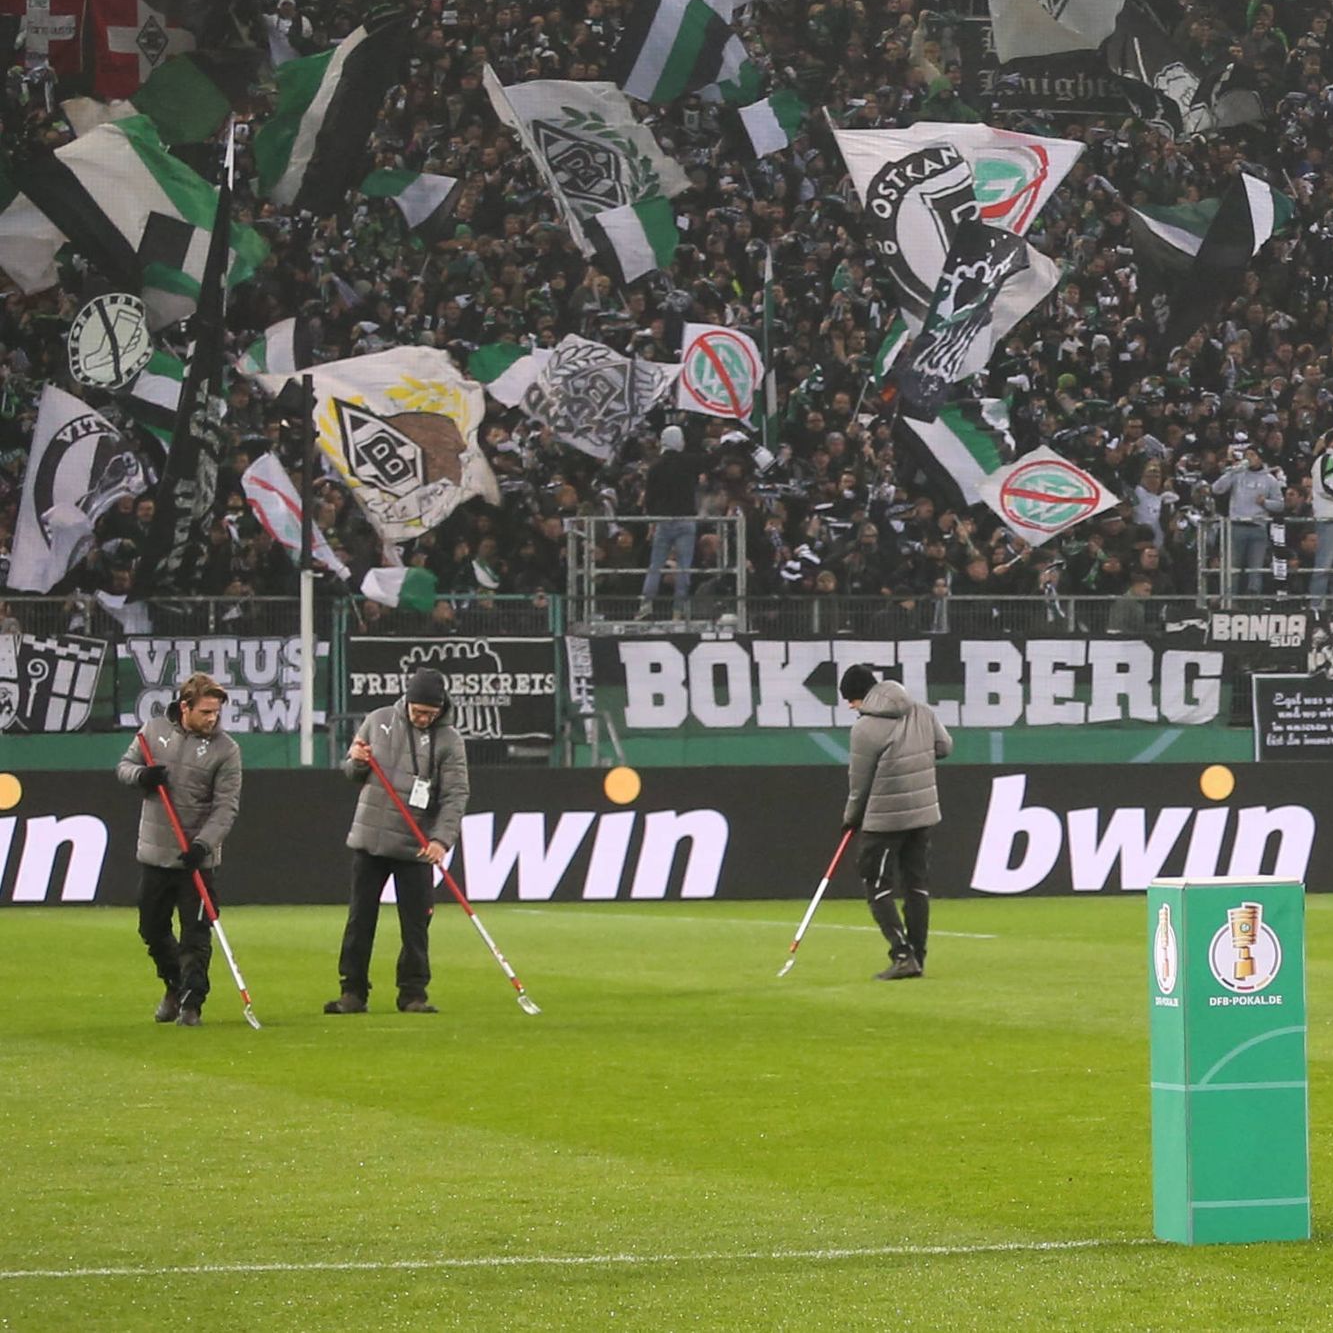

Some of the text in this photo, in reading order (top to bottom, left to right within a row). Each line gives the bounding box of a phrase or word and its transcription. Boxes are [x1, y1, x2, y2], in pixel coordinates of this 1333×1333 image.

[1211, 613, 1307, 643] BANDA
[135, 686, 310, 733] CEW
[379, 766, 730, 902] win
[968, 764, 1318, 895] bwin
